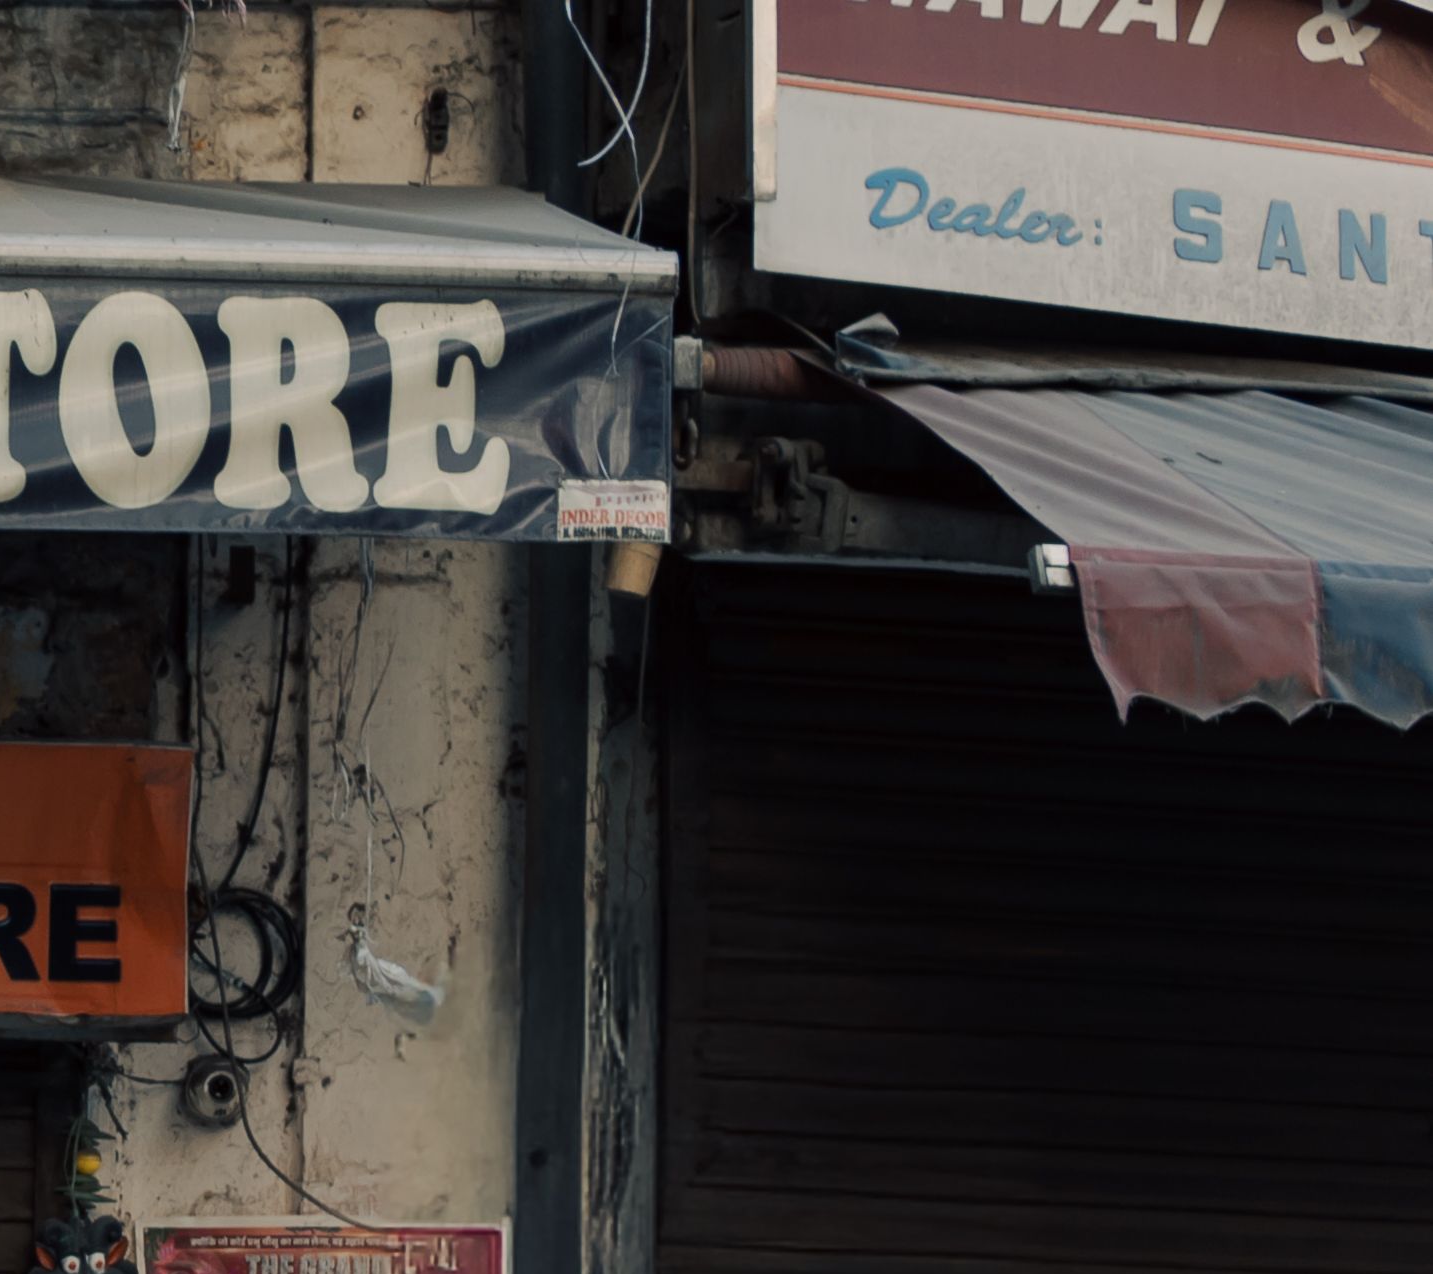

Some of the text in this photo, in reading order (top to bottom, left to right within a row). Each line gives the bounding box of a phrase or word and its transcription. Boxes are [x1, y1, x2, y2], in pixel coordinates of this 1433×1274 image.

[865, 167, 1104, 247] Dealer:
[562, 508, 666, 528] INDER DECOR
